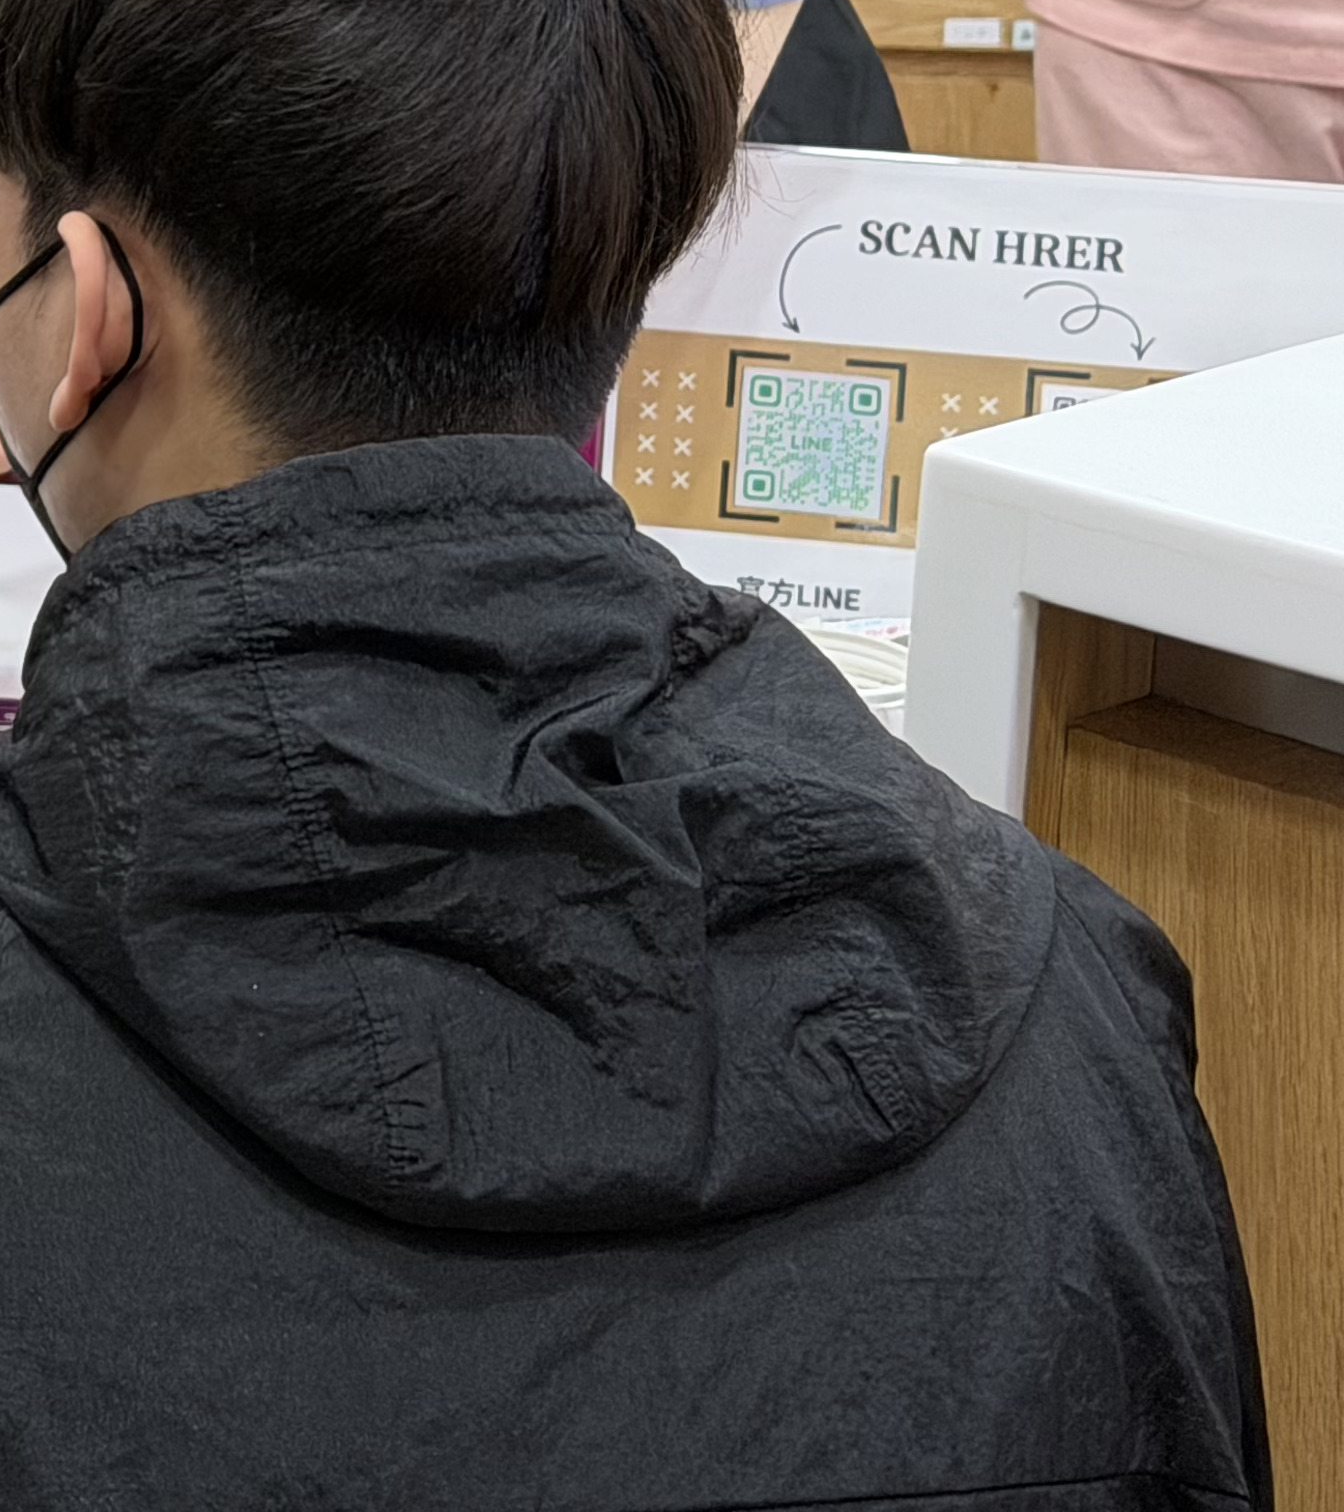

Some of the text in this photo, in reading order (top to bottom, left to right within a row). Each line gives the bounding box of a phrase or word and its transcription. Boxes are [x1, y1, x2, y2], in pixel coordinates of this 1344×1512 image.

[858, 219, 1125, 274] SCAN HRER
[789, 434, 834, 453] LINE
